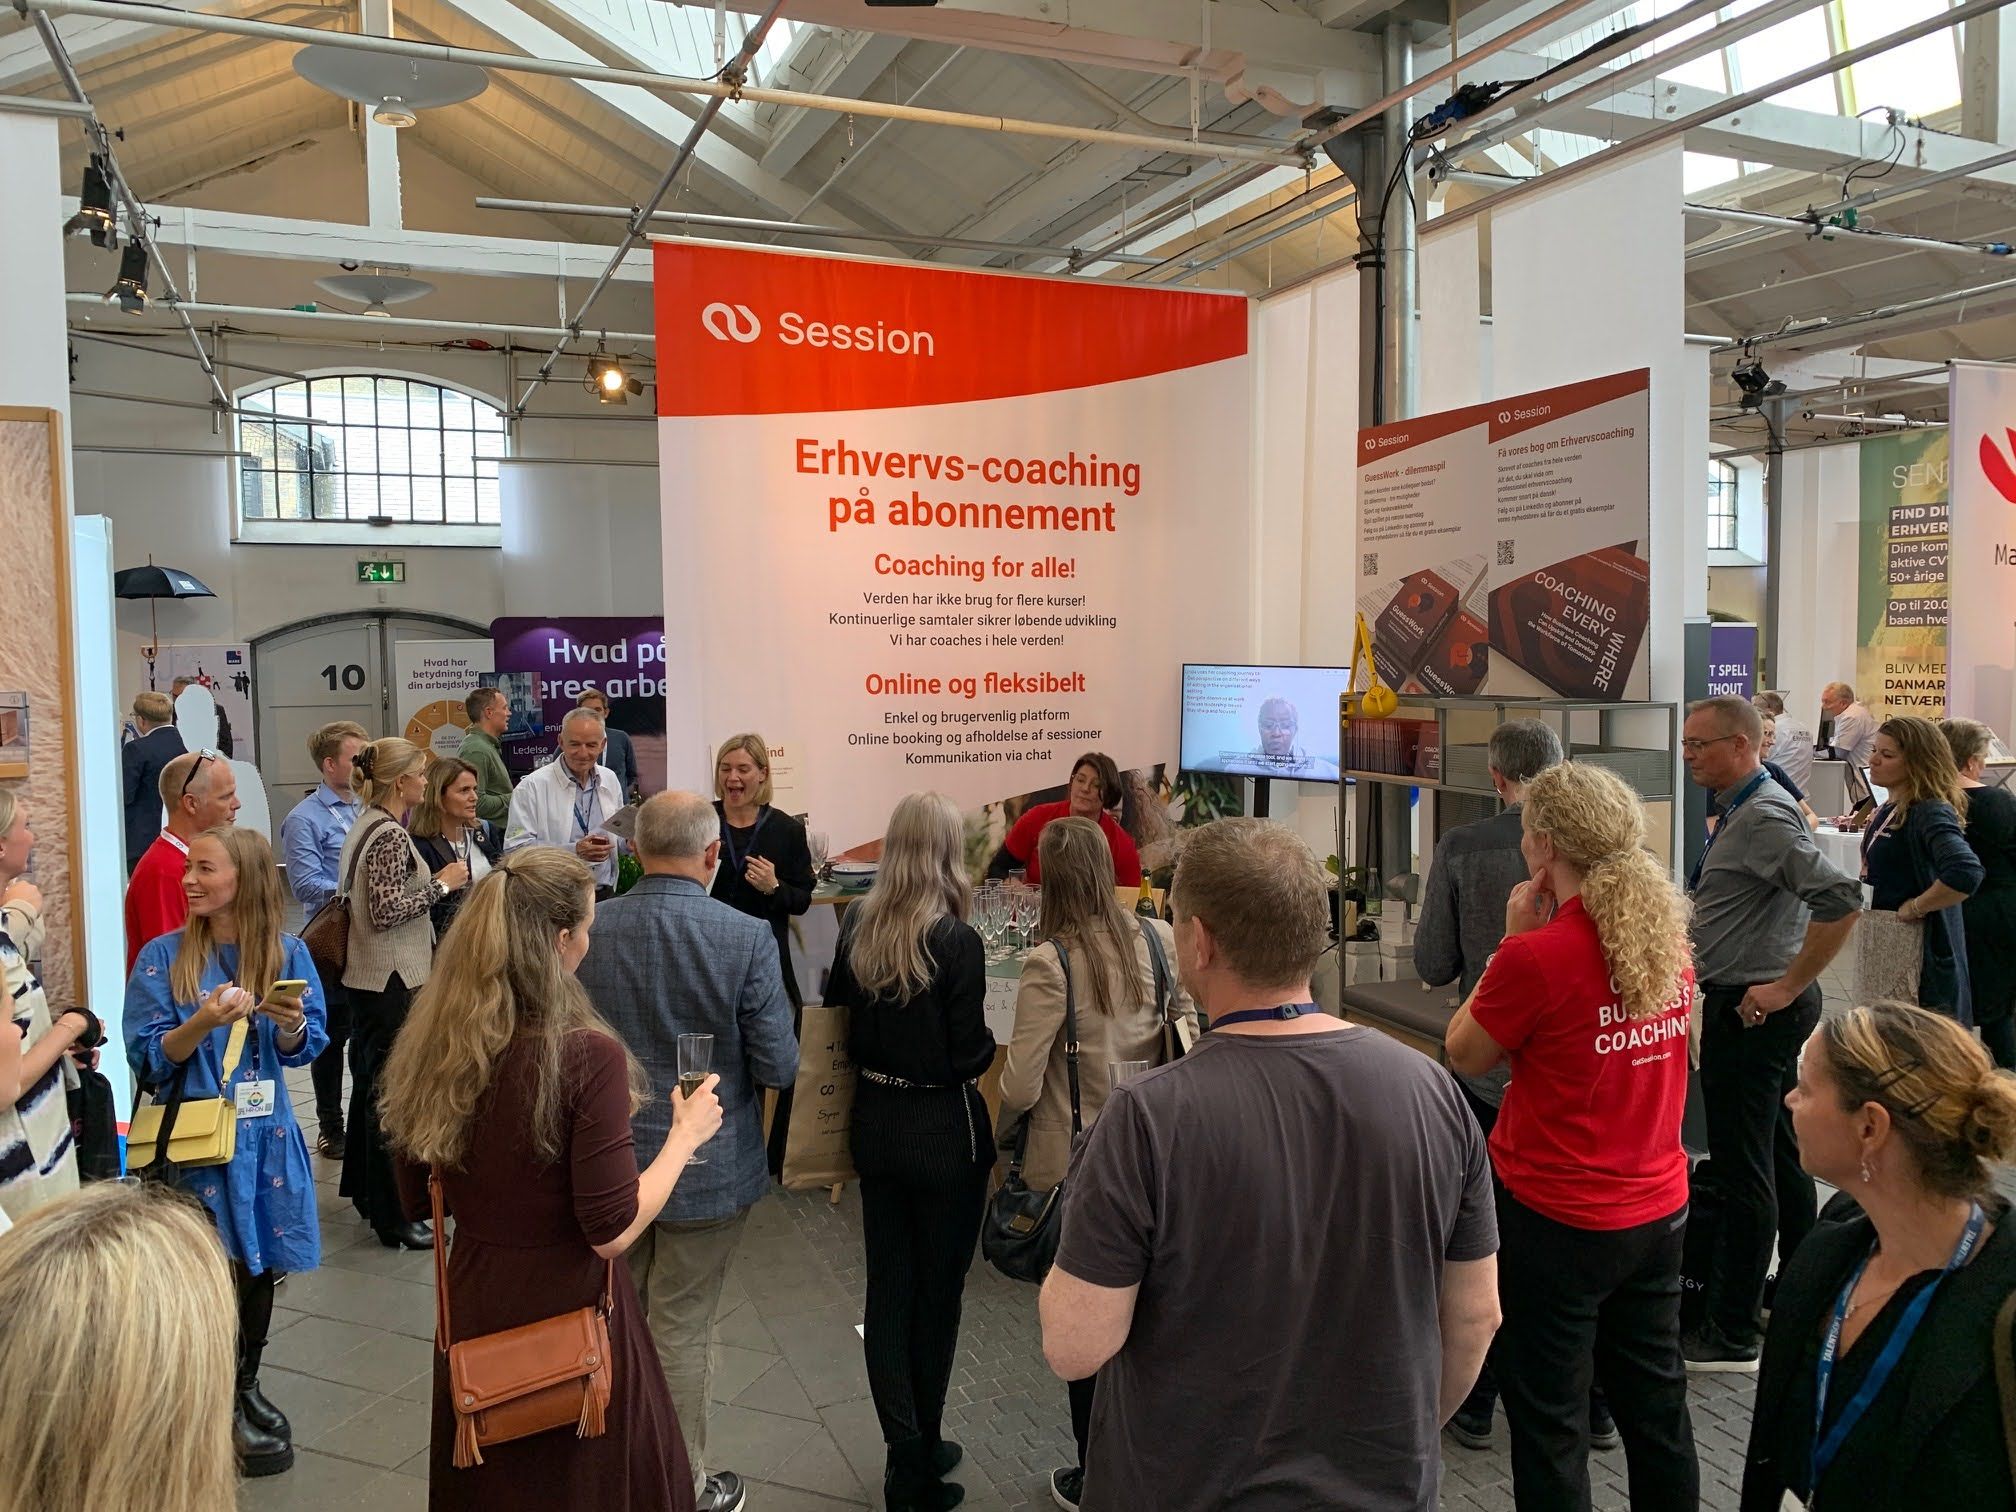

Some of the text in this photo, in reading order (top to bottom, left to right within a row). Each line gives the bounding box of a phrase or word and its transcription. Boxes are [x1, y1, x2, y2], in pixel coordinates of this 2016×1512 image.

[778, 311, 934, 357] Session
[1514, 405, 1550, 420] Session
[1378, 434, 1409, 447] Session
[1498, 427, 1634, 458] Få vores bog om Erhvervscoaching
[795, 437, 1141, 496] Erhvervs-coaching
[1365, 469, 1399, 482] GuessWork
[1405, 460, 1445, 475] dilemmaspil
[1575, 497, 1581, 505] på
[828, 487, 1116, 532] på abonnement
[1892, 508, 1925, 520] FIND
[1892, 522, 1948, 536] ERHVER
[1892, 542, 1947, 553] Dine kom
[875, 553, 1075, 581] Coaching for alle!
[1891, 557, 1925, 568] aktive
[1890, 571, 1944, 582] 50+ årige
[863, 592, 1086, 608] Verden har ikke brug for flere kurser!
[1535, 572, 1616, 622] COACHING
[1890, 600, 1948, 612] Op til 20.0
[829, 613, 1117, 628] Kontinuerlige samtaler sikrer løbende udvikling
[1393, 605, 1424, 636] GuessWork
[1563, 605, 1610, 638] EVERY
[1889, 616, 1923, 625] basen
[1538, 618, 1596, 656] Can Upskill and Develop
[1541, 612, 1599, 649] How Business Coaching
[890, 634, 1064, 645] Vi har coaches i hele verden!
[1536, 625, 1560, 643] Workforce
[1567, 643, 1593, 663] Tomorrow
[549, 638, 627, 664] Hvad
[424, 659, 448, 667] Hvad
[1593, 632, 1626, 692] WHERE
[1886, 664, 1914, 673] BLIV
[320, 664, 365, 691] 10
[413, 669, 479, 679] betydning for
[1709, 664, 1748, 676] T SPELL
[426, 681, 479, 690] arbejdslyst
[865, 672, 1086, 699] Online og fleksibelt
[1708, 683, 1743, 695] THOUT
[1885, 680, 1945, 689] DANMAR
[884, 709, 1070, 725] Enkel og brugervenlig platform
[848, 729, 1102, 746] Online booking og afholdelse af sessioner
[513, 746, 548, 755] Ledelse
[905, 749, 1052, 764] Kommunikation via chat
